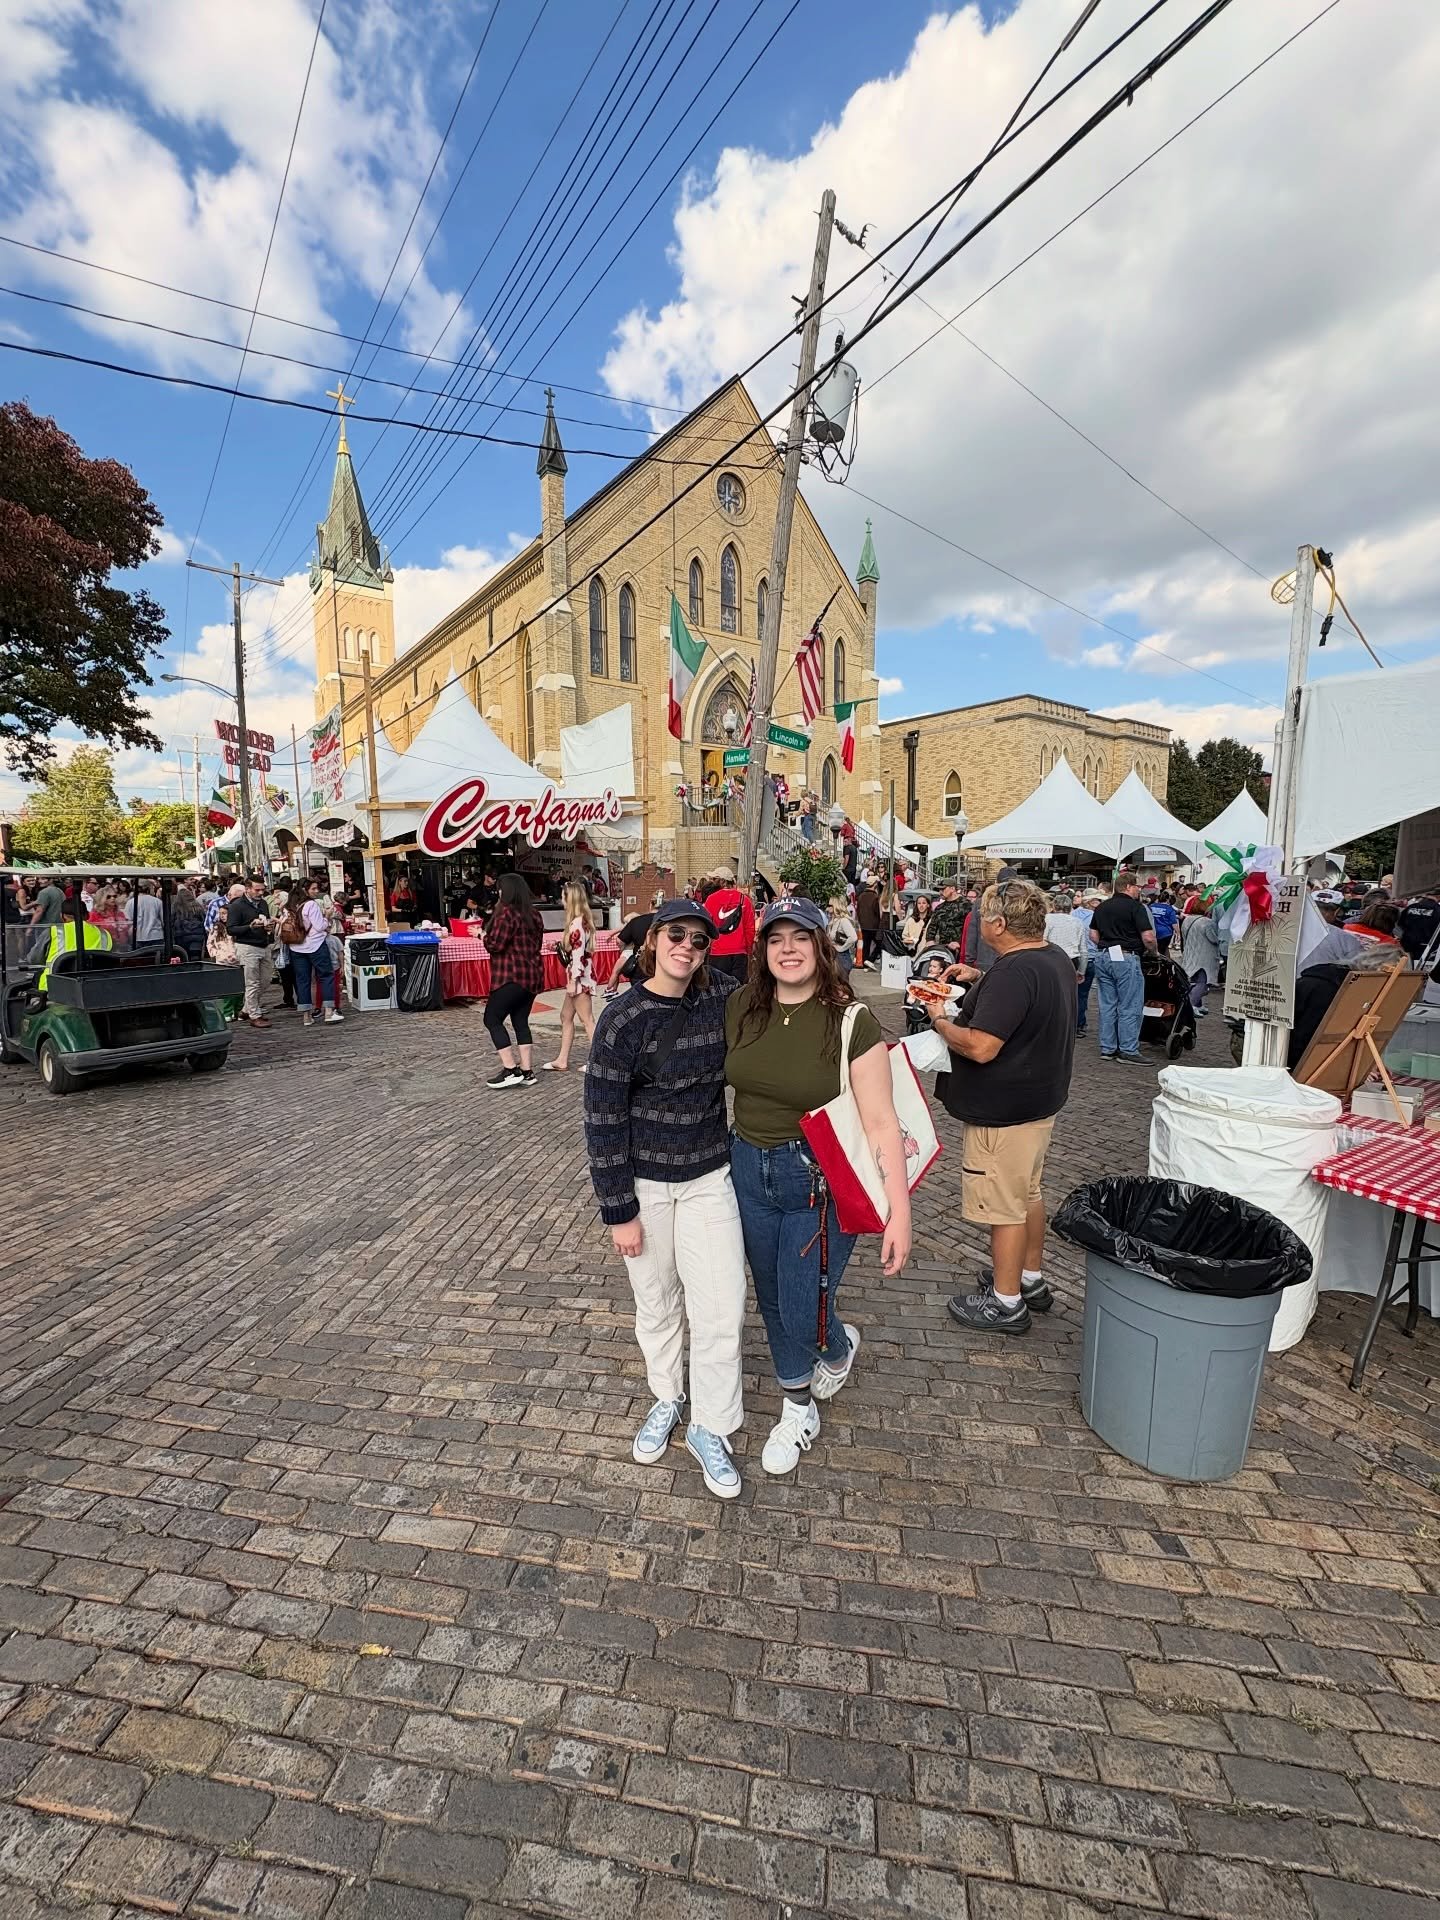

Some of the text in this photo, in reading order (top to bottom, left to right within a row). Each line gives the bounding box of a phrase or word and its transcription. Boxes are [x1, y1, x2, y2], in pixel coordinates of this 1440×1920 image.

[214, 720, 274, 752] WODER
[775, 731, 799, 746] Lincoln
[726, 753, 746, 763] Hamlet
[422, 779, 620, 853] Carfagna's
[771, 899, 801, 910] ITALIA
[362, 966, 392, 977] WM
[1244, 985, 1273, 995] DIRECTLY
[1243, 991, 1286, 1003] PRESERVATION
[1239, 1008, 1263, 1017] BAPTIST
[1264, 1014, 1290, 1023] CHURCH
